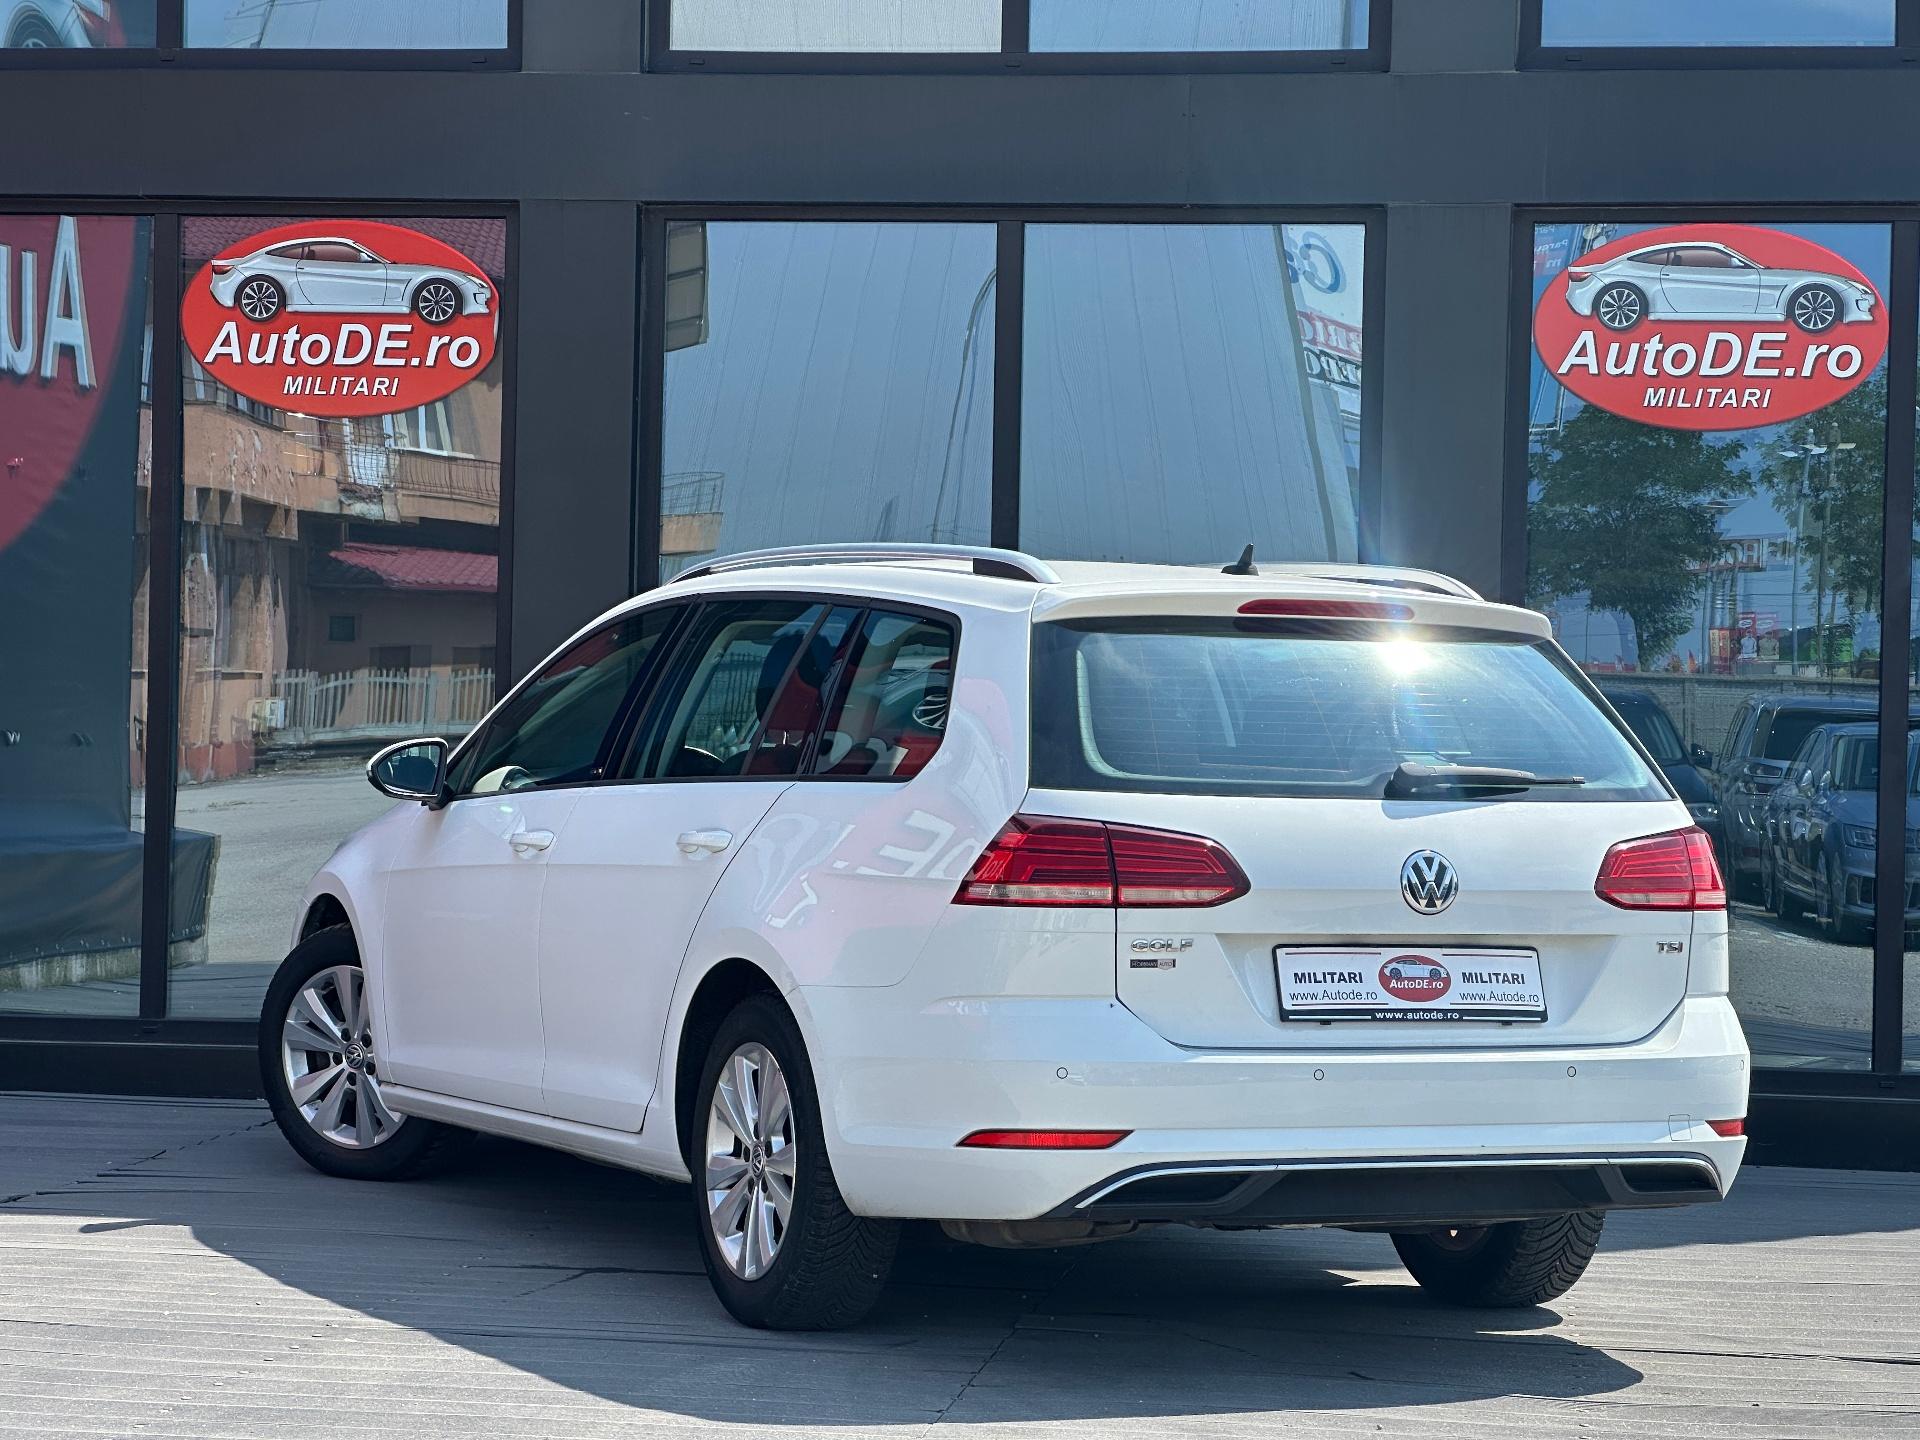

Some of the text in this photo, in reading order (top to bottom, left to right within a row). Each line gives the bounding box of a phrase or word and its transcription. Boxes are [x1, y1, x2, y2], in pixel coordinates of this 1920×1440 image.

[203, 321, 480, 368] AutoDE.ro
[1557, 330, 1862, 378] AutoDE.ro
[282, 376, 399, 396] MILITARI
[1643, 387, 1771, 408] MILITARI
[1131, 938, 1193, 953] GOLF
[1656, 941, 1683, 953] TSI
[1293, 971, 1363, 984] MILITARI
[1461, 971, 1525, 985] MILITARI
[1389, 979, 1444, 990] AutoDE.ro
[1289, 989, 1378, 1001] www.Autode.ro
[1459, 990, 1540, 1003] www.Autode.ro
[1375, 1010, 1460, 1020] www.autode.ro
